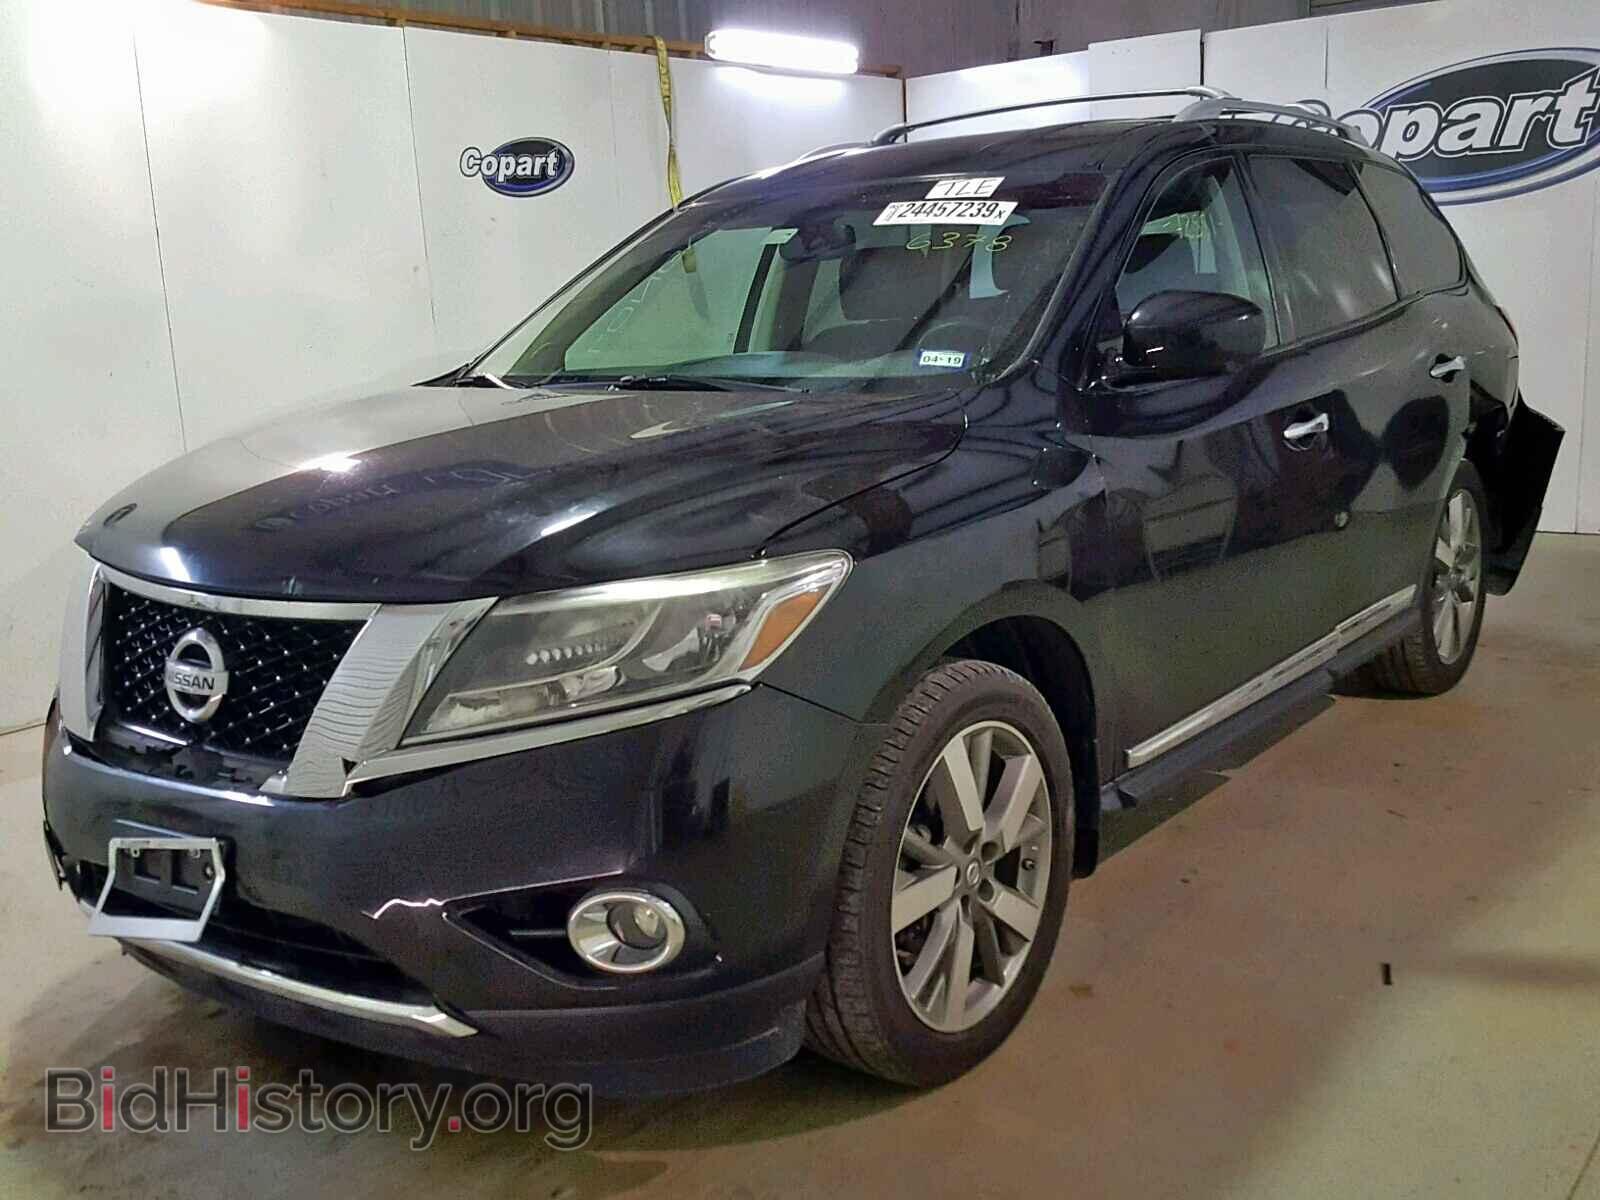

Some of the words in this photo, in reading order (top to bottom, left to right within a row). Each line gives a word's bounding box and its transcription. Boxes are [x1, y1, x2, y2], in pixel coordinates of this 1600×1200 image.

[1300, 65, 1600, 160] opart
[460, 146, 560, 184] Copart
[899, 201, 999, 218] 24457239
